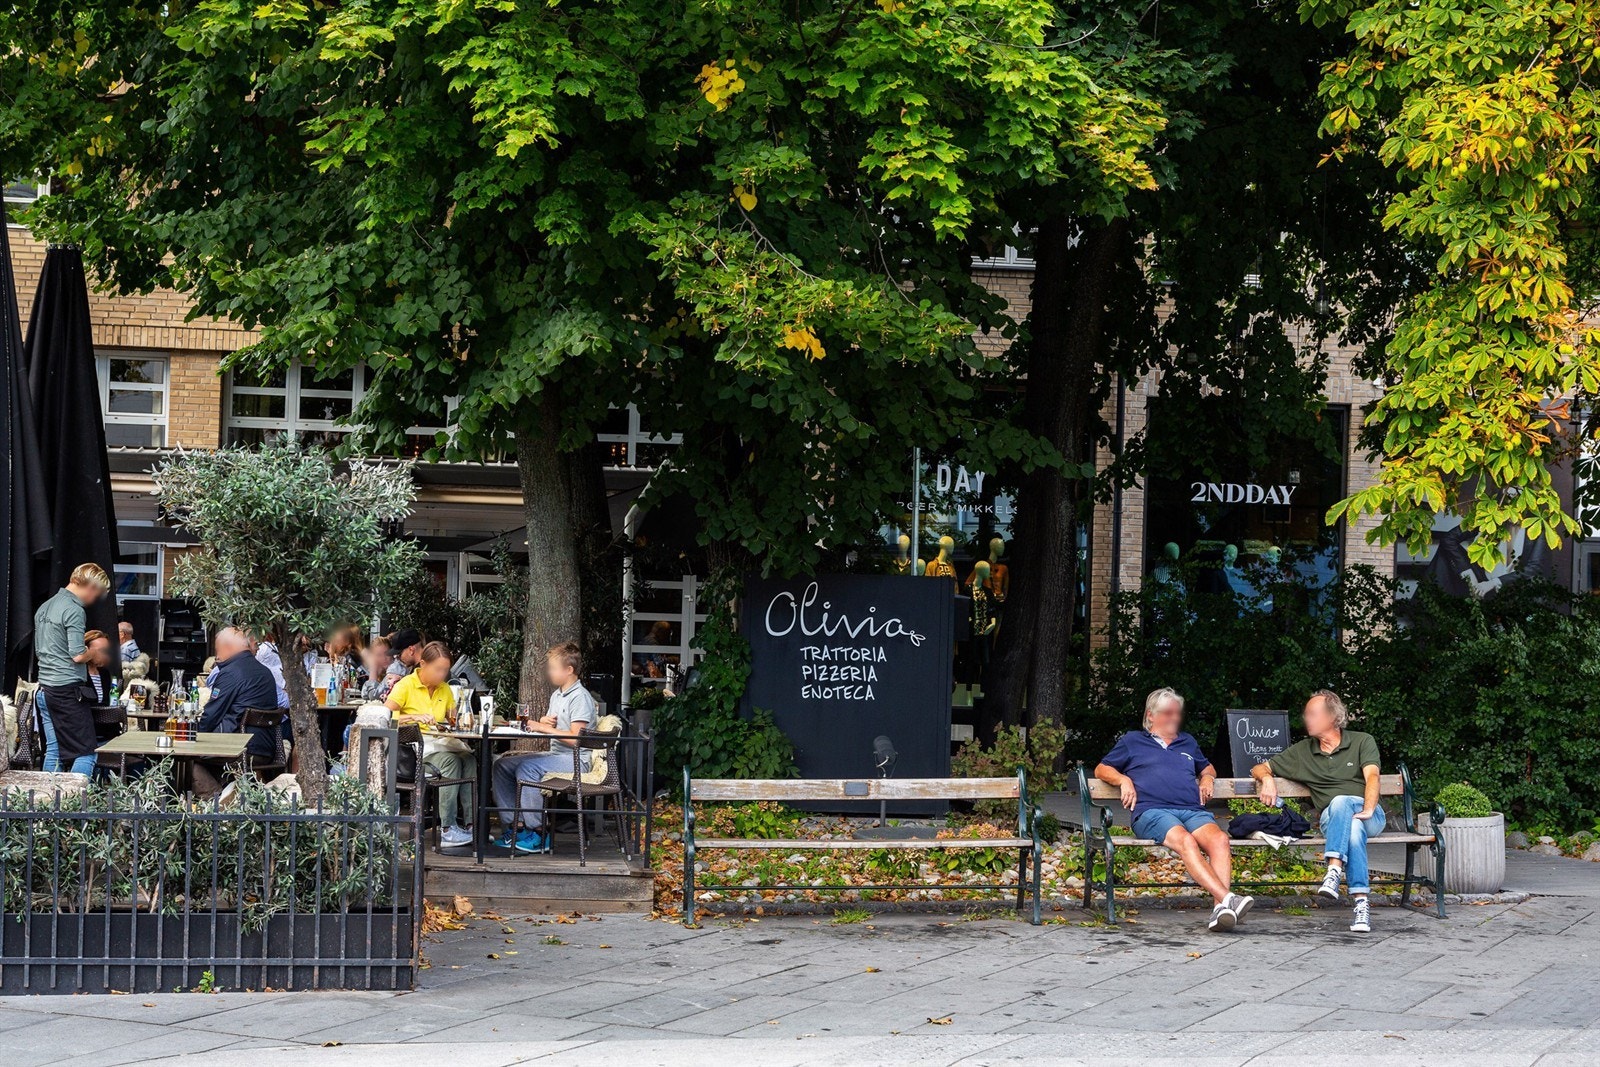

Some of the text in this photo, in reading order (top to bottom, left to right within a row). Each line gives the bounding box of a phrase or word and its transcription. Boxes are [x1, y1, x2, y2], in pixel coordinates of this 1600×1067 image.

[936, 464, 986, 494] DAY
[1190, 482, 1297, 505] 2NDDAY
[765, 581, 914, 639] Olivia
[800, 644, 887, 662] TRATTORIA
[801, 664, 878, 682] PIZZERIA
[801, 684, 875, 700] ENOTECA
